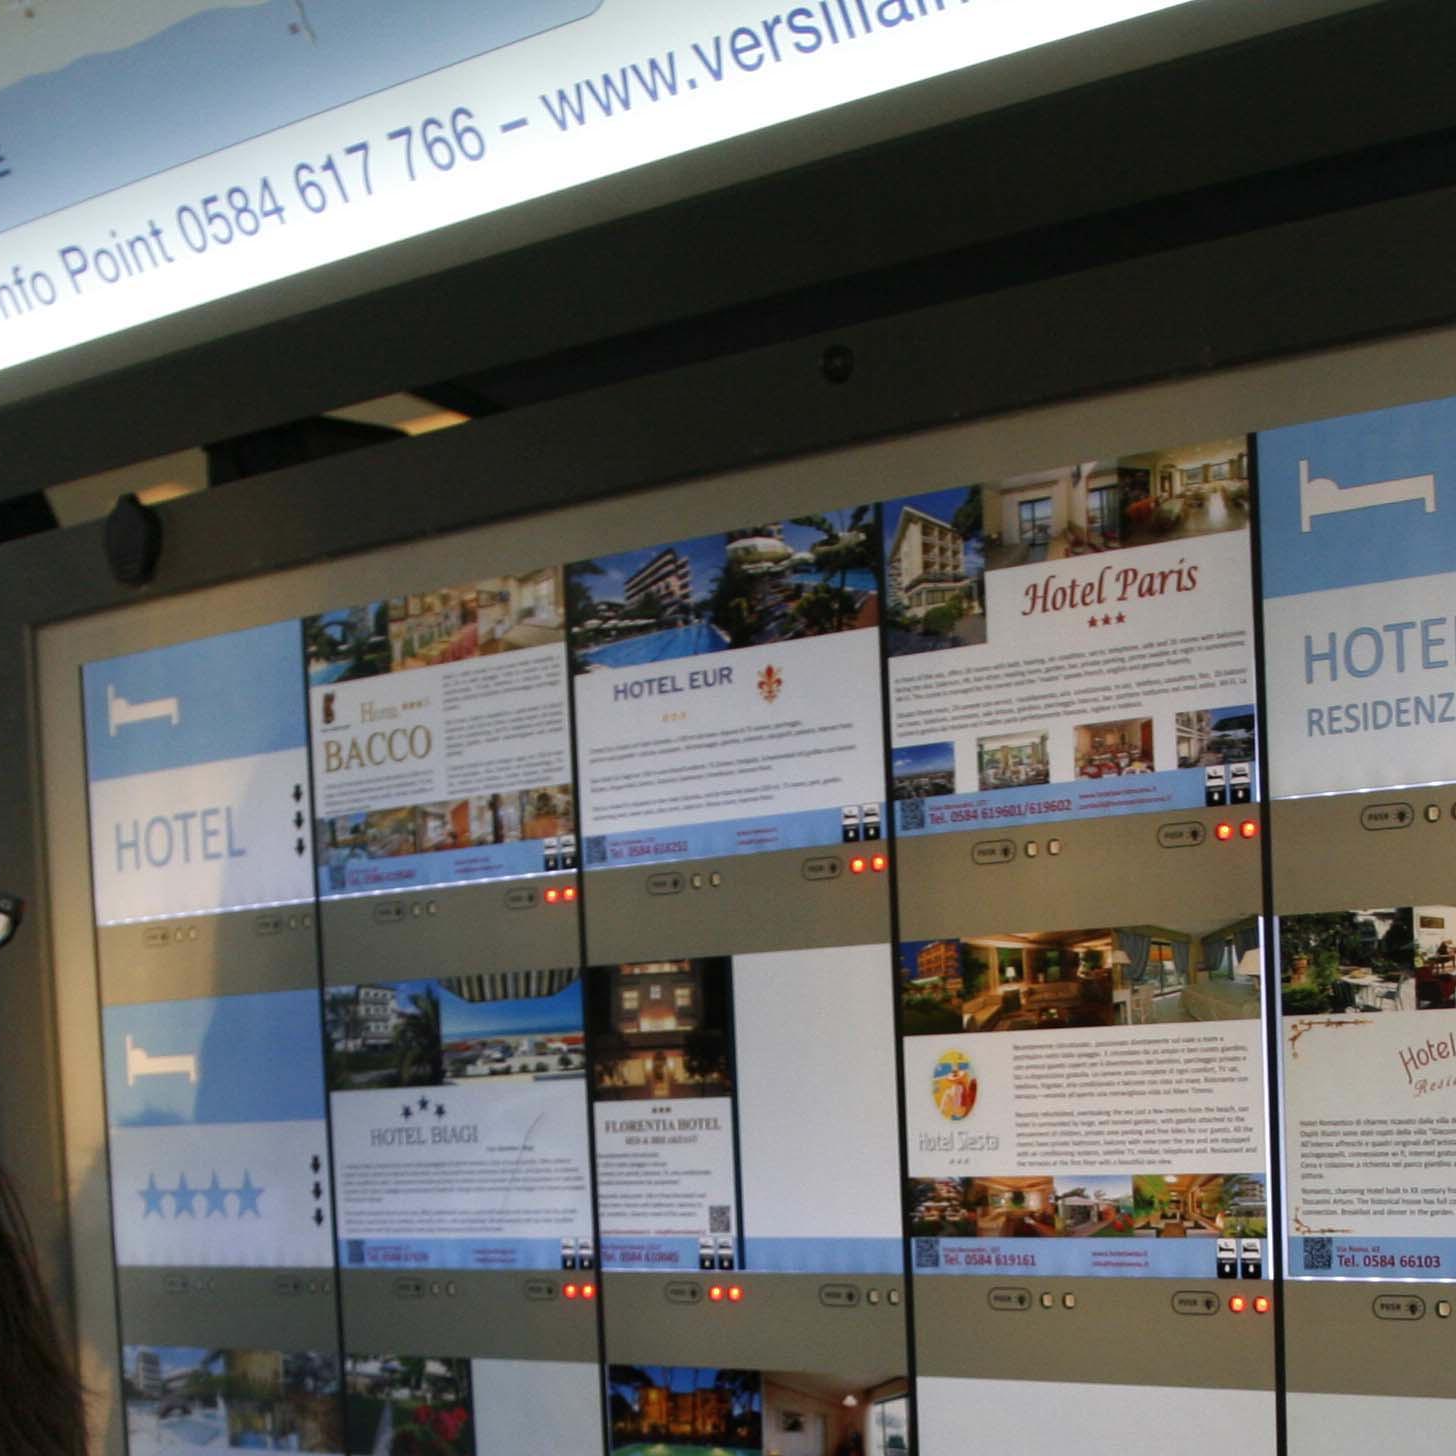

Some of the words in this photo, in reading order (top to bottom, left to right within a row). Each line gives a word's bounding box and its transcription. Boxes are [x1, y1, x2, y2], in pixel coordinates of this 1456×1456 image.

[59, 219, 175, 294] Point
[175, 176, 287, 253] 0584
[293, 140, 374, 214] 617
[386, 106, 487, 182] 766
[1021, 565, 1113, 616] Hotel
[1115, 557, 1199, 602] Paris
[613, 676, 684, 701] HOTEL
[689, 666, 734, 690] EUR
[324, 724, 432, 773] BACCO
[114, 807, 246, 873] HOTEL
[1398, 1031, 1456, 1085] Hotel
[370, 1125, 426, 1147] HOTEL
[430, 1124, 479, 1144] BIAGI
[604, 1118, 677, 1133] FLORENTIA
[677, 1117, 723, 1131] HOTEL
[964, 1254, 993, 1266] 0584
[1336, 1254, 1359, 1268] Tel.
[1363, 1254, 1396, 1268] 0584
[1399, 1254, 1441, 1268] 66103
